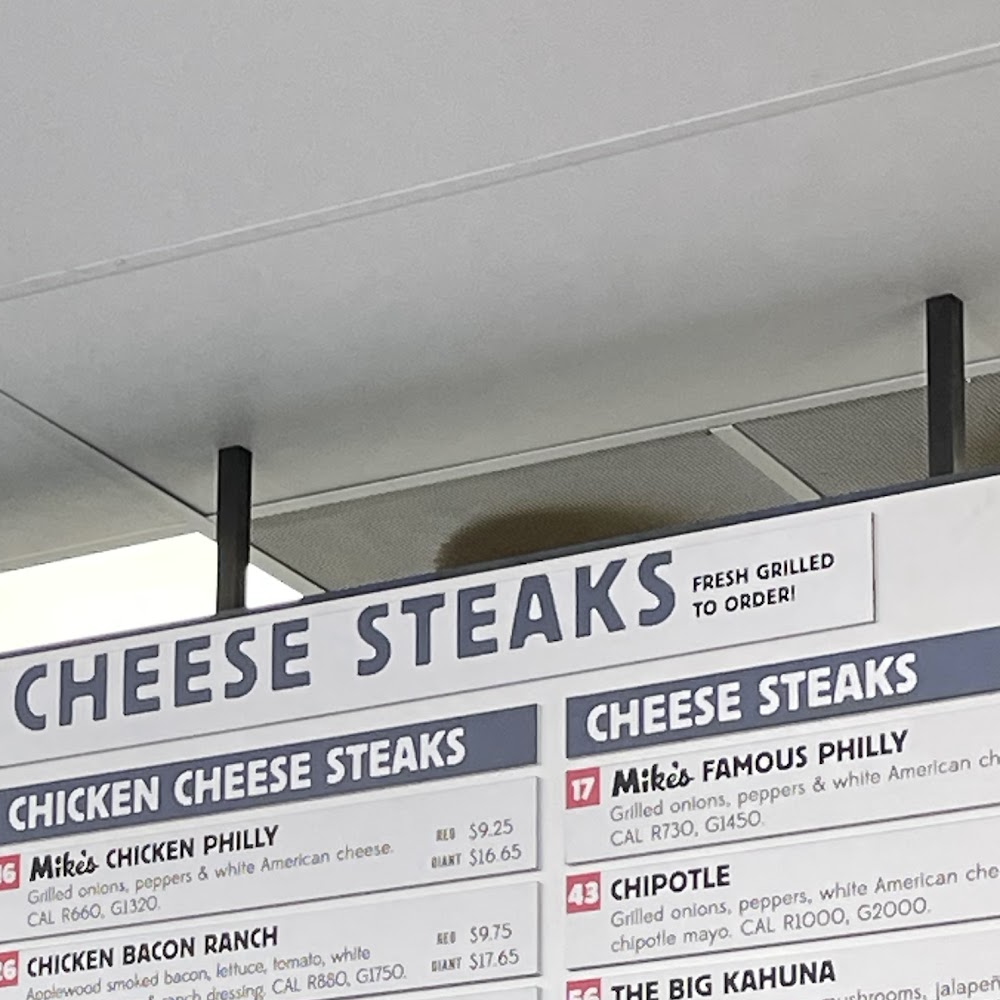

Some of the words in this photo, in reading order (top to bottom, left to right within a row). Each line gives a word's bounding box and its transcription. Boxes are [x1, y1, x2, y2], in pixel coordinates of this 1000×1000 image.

[693, 567, 749, 592] FRESH
[756, 552, 835, 580] GRILLED
[692, 599, 717, 617] TO
[724, 584, 795, 613] ORDER!
[14, 619, 311, 731] CHEESE
[358, 552, 676, 678] STEAKS
[587, 681, 742, 742] CHEESE
[758, 652, 918, 716] STEAKS
[8, 775, 159, 831] CHICKEN
[174, 751, 312, 807] CHEESE
[326, 726, 466, 785] STEAKS
[571, 776, 596, 802] 17
[611, 760, 695, 798] Mike's
[702, 745, 808, 783] FAMOUS
[818, 729, 908, 765] PHILLY
[609, 798, 664, 823] Grilled
[669, 794, 731, 814] onions,
[737, 783, 806, 809] peppers
[812, 775, 826, 793] &
[832, 770, 881, 790] white
[887, 758, 971, 782] American
[468, 818, 514, 841] $9.25
[609, 827, 644, 847] CAL
[650, 819, 699, 842] R730,
[704, 809, 765, 834] G1450.
[29, 849, 100, 882] Mike's
[106, 837, 195, 869] CHICKEN
[203, 824, 279, 856] PHILLY
[468, 843, 522, 867] $16.65
[569, 881, 598, 906] 43
[610, 864, 730, 901] CHIPOTLE
[27, 947, 114, 978] CHICKEN
[122, 936, 196, 966] BACON
[204, 925, 278, 956] RANCH
[470, 922, 513, 944] $9.75
[469, 948, 520, 971] $17.65
[669, 974, 713, 1000] BIG
[723, 959, 836, 995] KAHUNA
